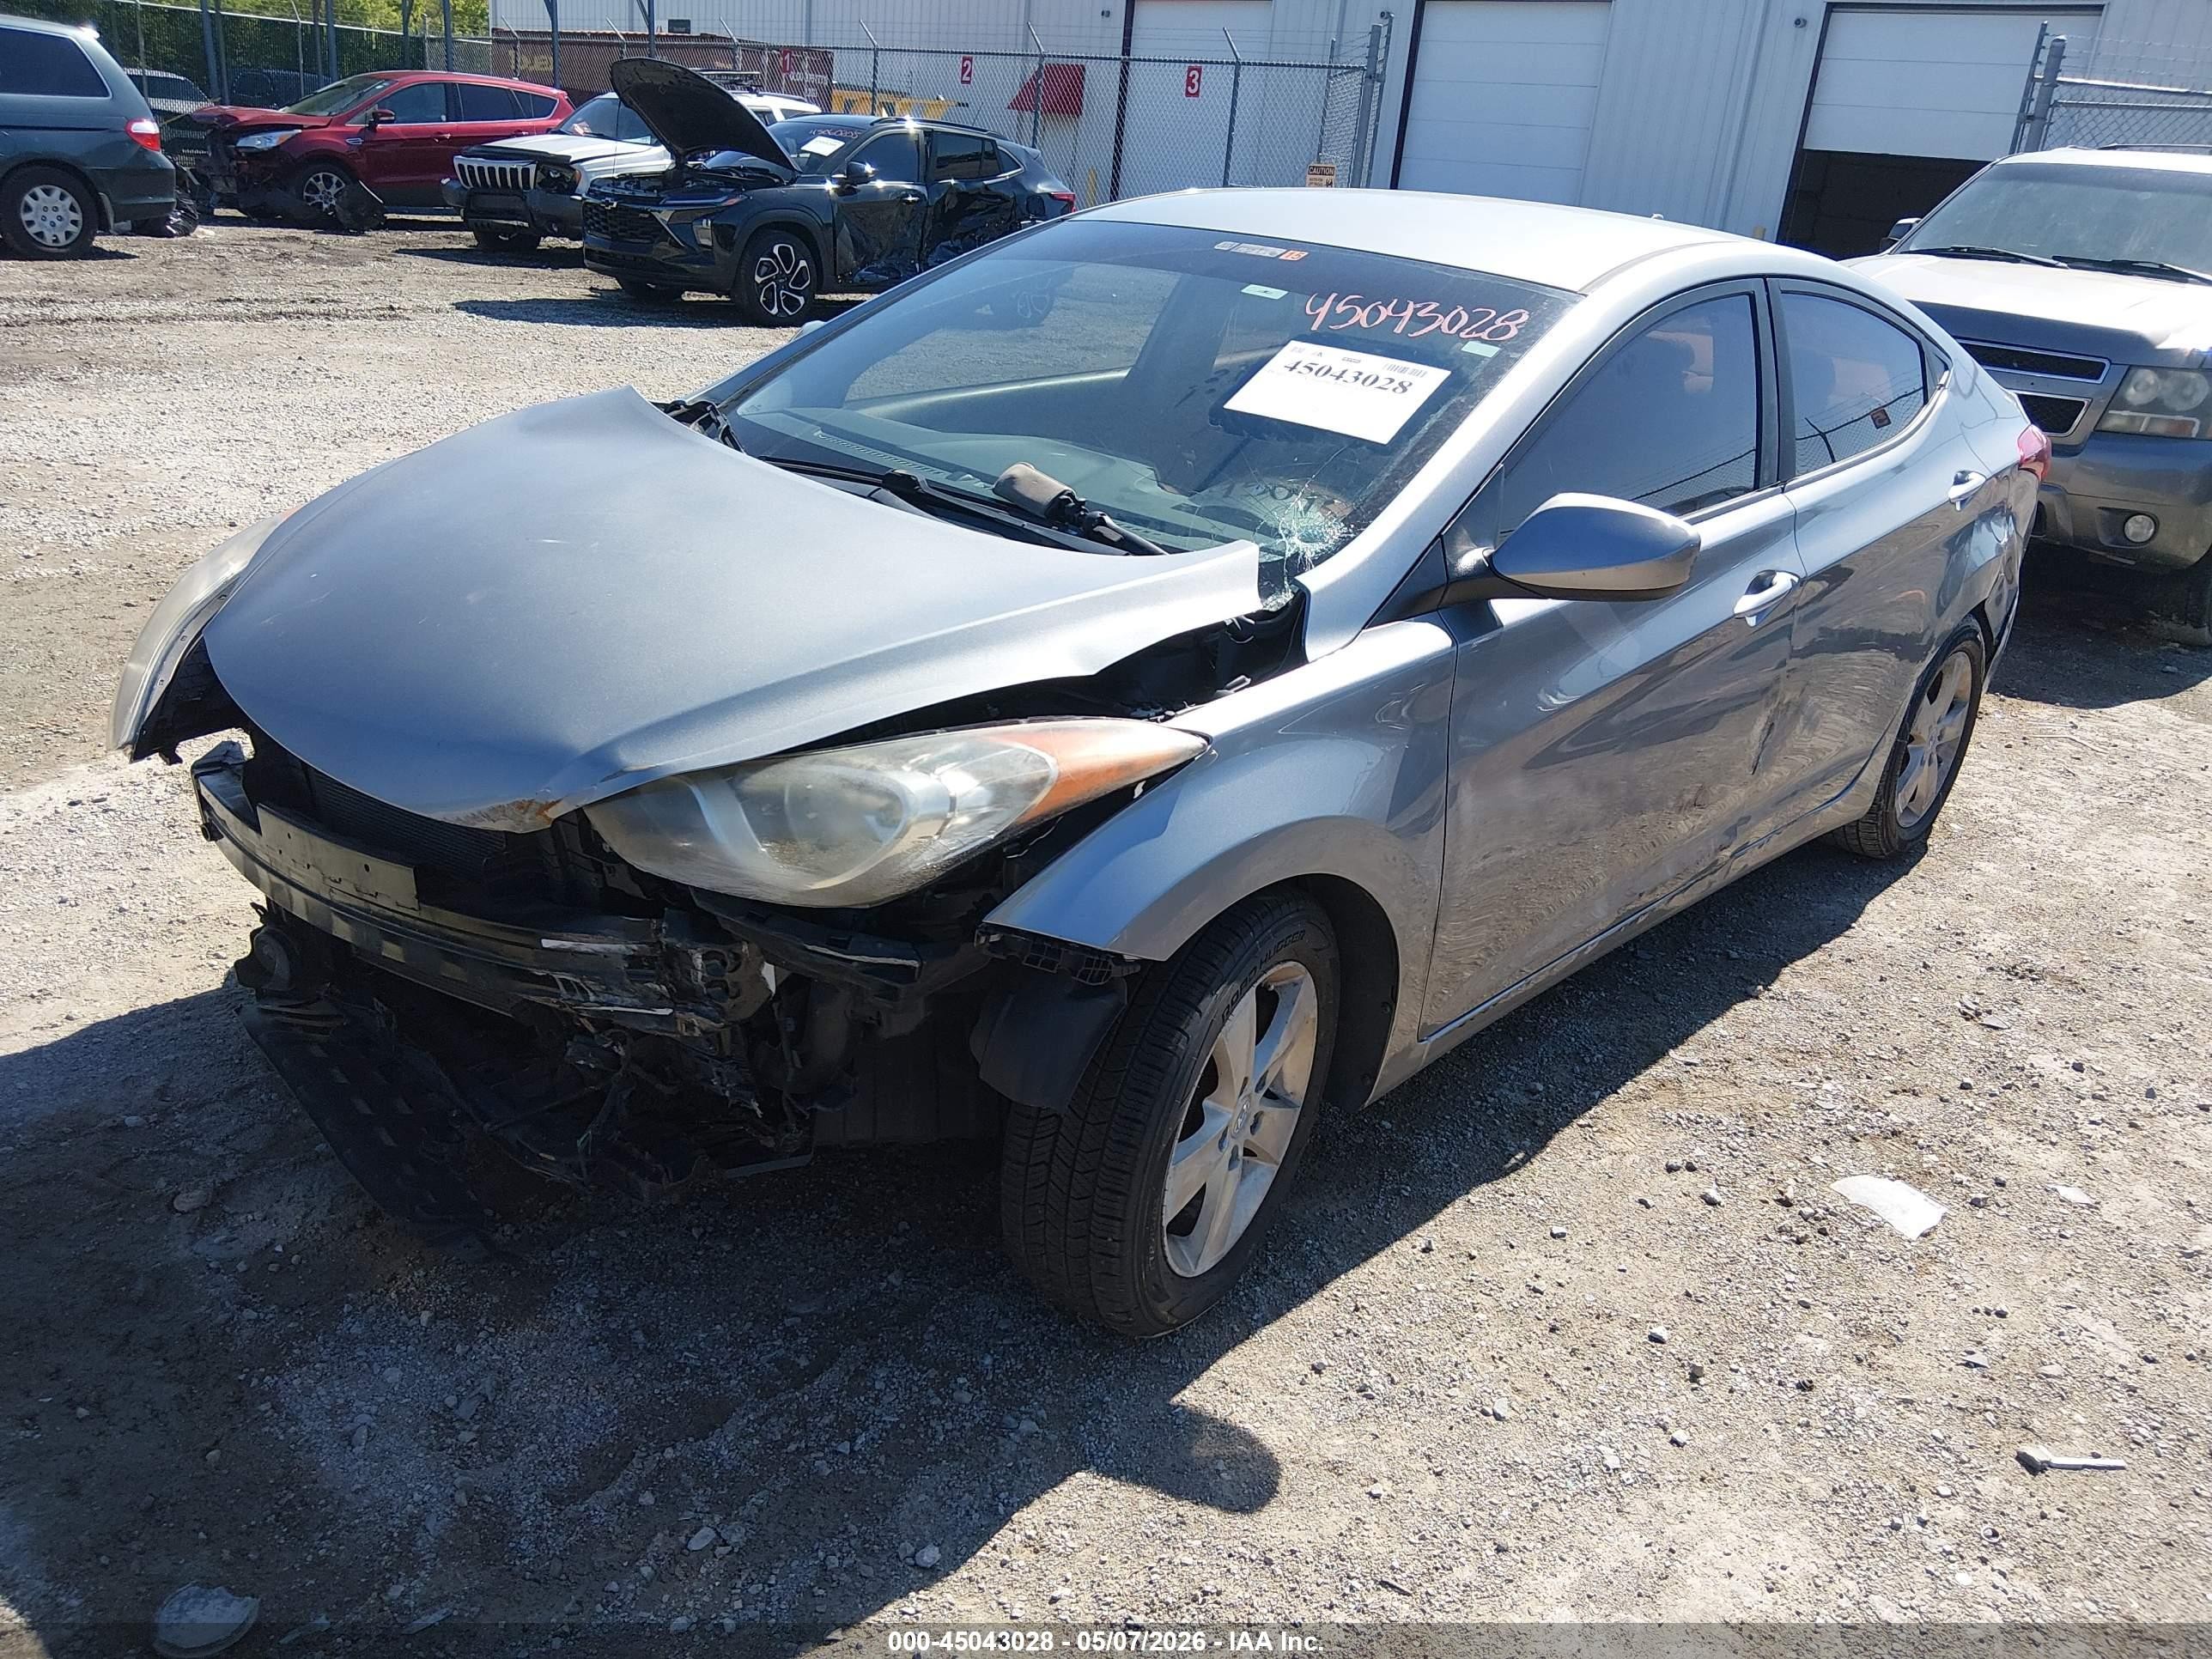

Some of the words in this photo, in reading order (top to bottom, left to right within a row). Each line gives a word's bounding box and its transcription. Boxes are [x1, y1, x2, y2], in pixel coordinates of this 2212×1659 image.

[784, 52, 791, 72] 1
[962, 60, 971, 82] 2
[1188, 70, 1199, 94] 3
[1309, 167, 1334, 175] CAUTION
[1305, 293, 1530, 341] 45043028
[1284, 360, 1413, 395] 45043028
